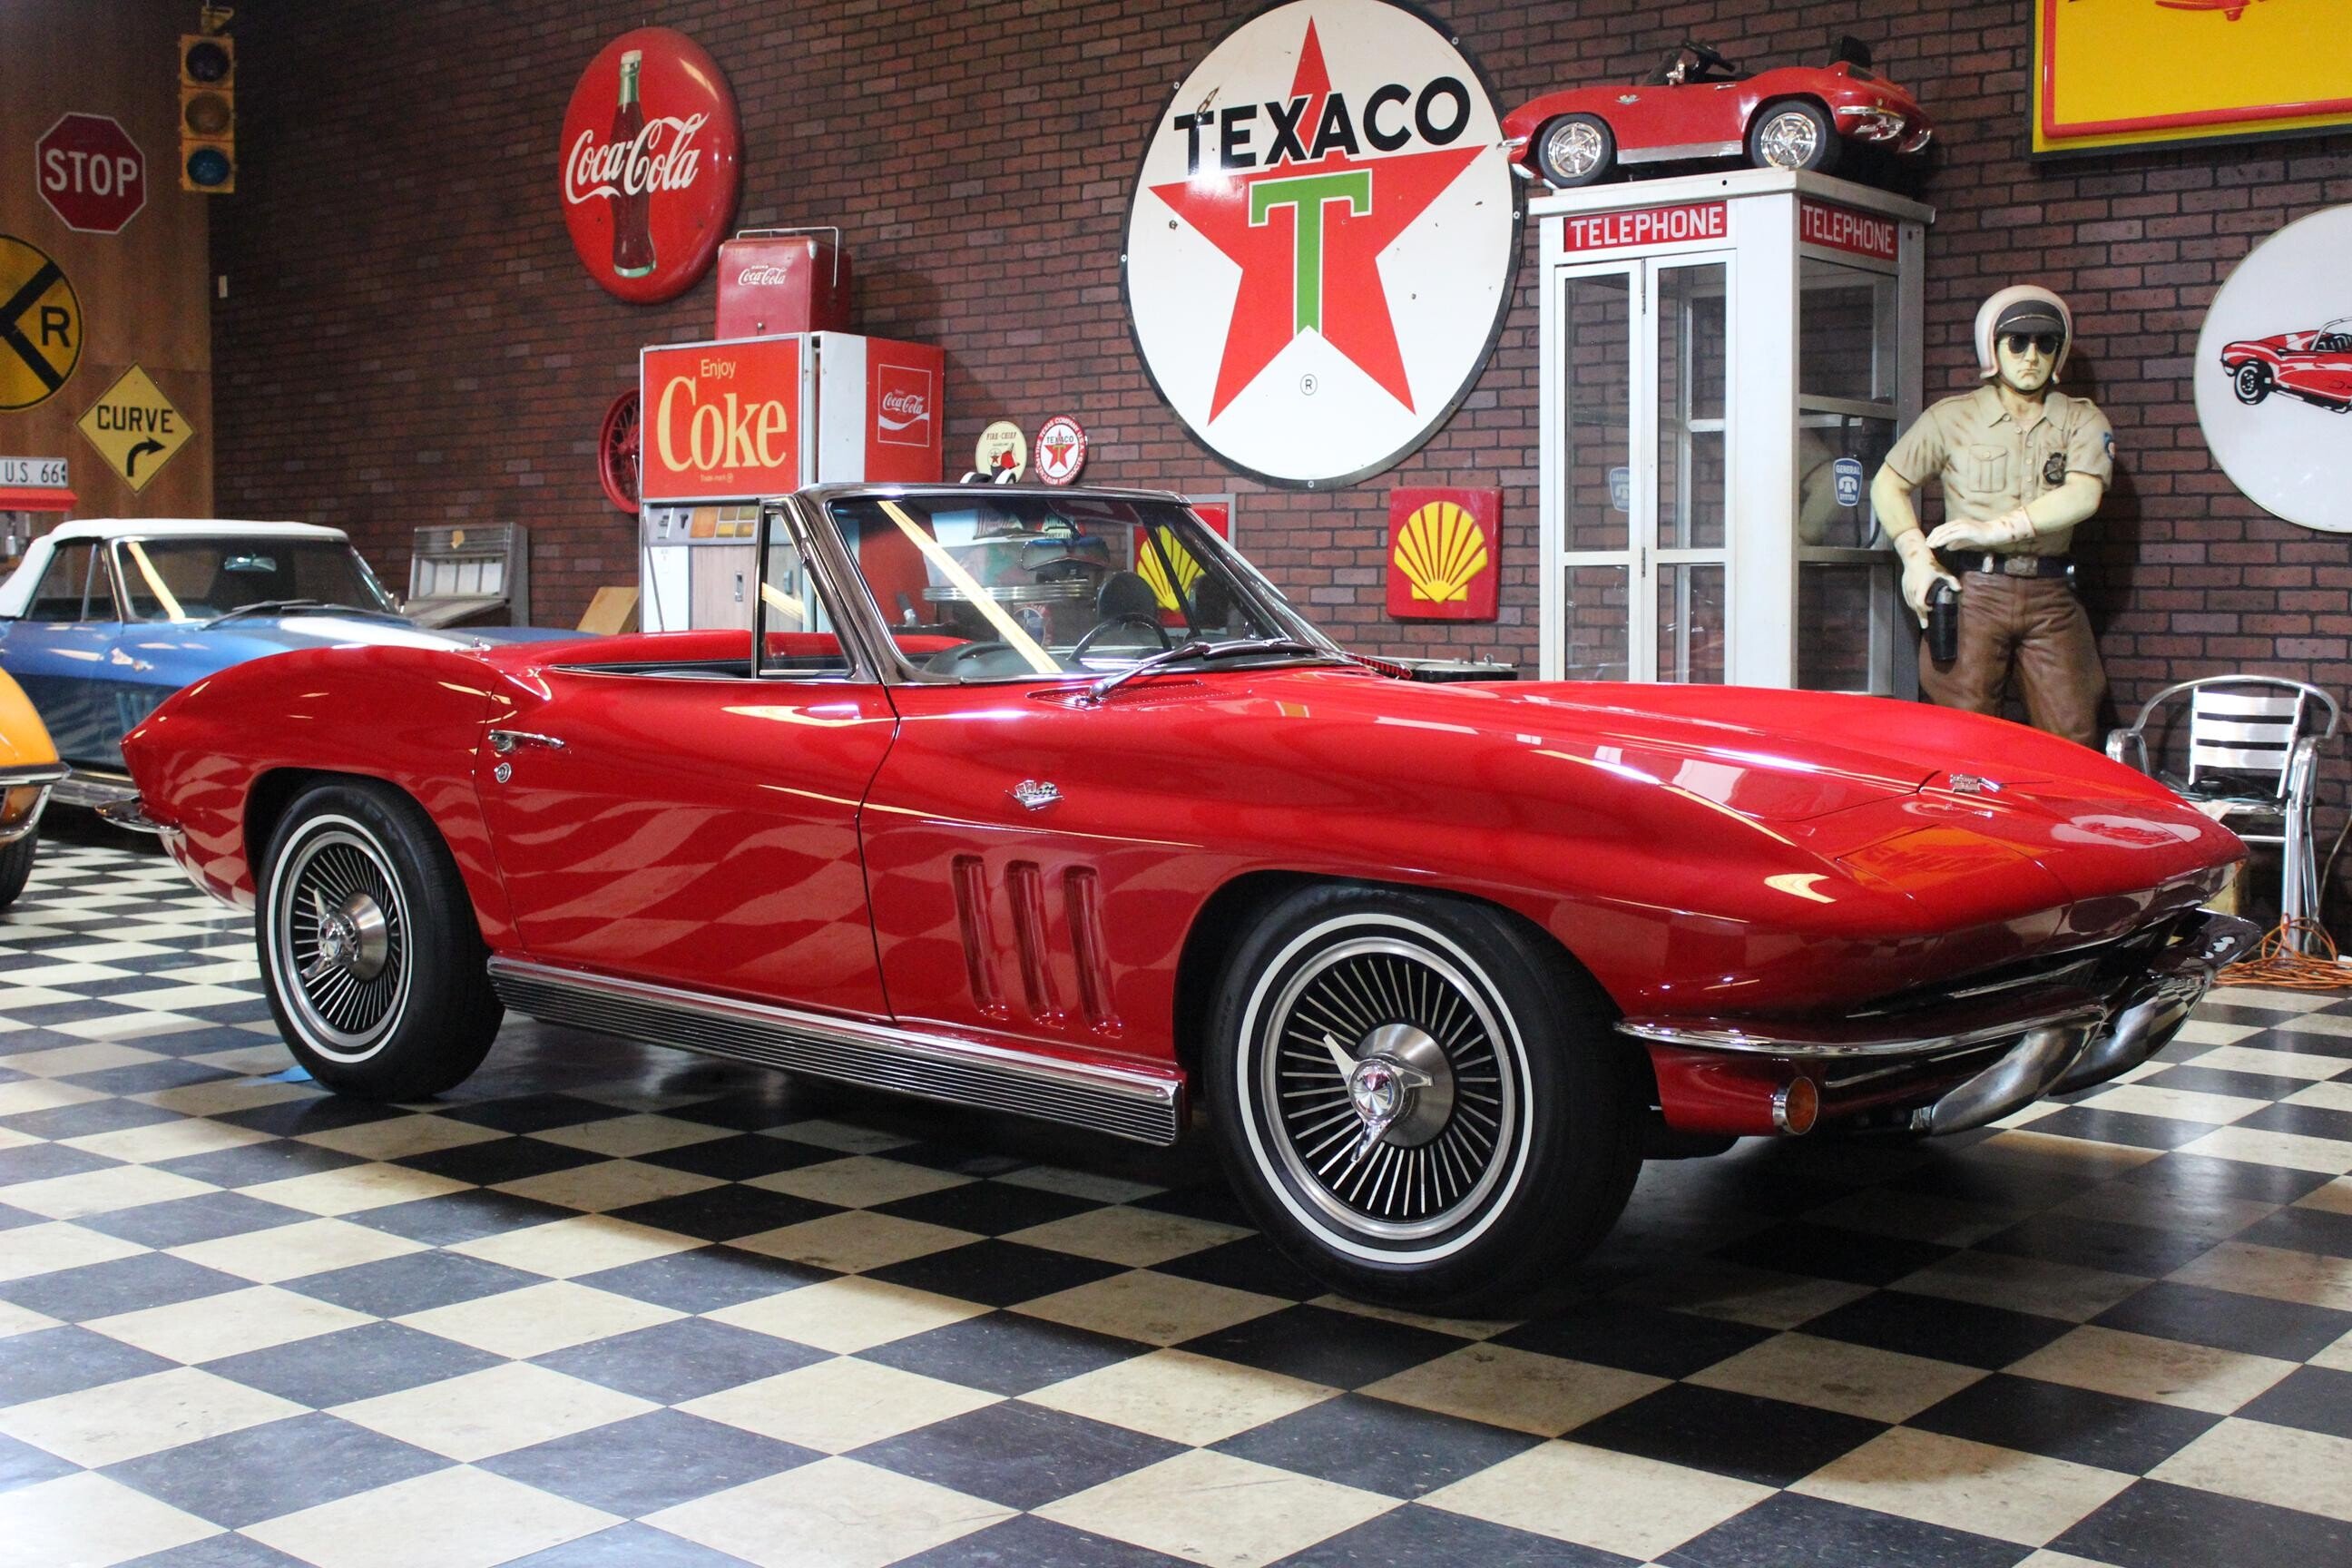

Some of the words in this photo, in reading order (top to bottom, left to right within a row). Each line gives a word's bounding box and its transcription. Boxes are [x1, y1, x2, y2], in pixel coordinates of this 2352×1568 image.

[1174, 76, 1471, 176] TEXACO
[45, 148, 138, 198] STOP
[565, 112, 710, 205] Coca-Cola
[1570, 205, 1723, 248] TELEPHONE
[1801, 204, 1894, 255] TELEPHONE
[738, 267, 788, 286] Coca-Cola
[41, 305, 71, 348] R
[701, 358, 737, 379] Enjoy
[882, 391, 925, 415] Coca-Cola
[97, 405, 174, 434] CURVE
[657, 376, 788, 472] Coke
[1041, 420, 1054, 437] TEXAS
[1054, 416, 1079, 433] COMPANY
[1046, 436, 1074, 444] TEXACO
[5, 461, 33, 483] U.S.
[41, 463, 59, 483] 66
[1059, 456, 1083, 485] PRODUCTS
[1836, 464, 1860, 475] GENERAL
